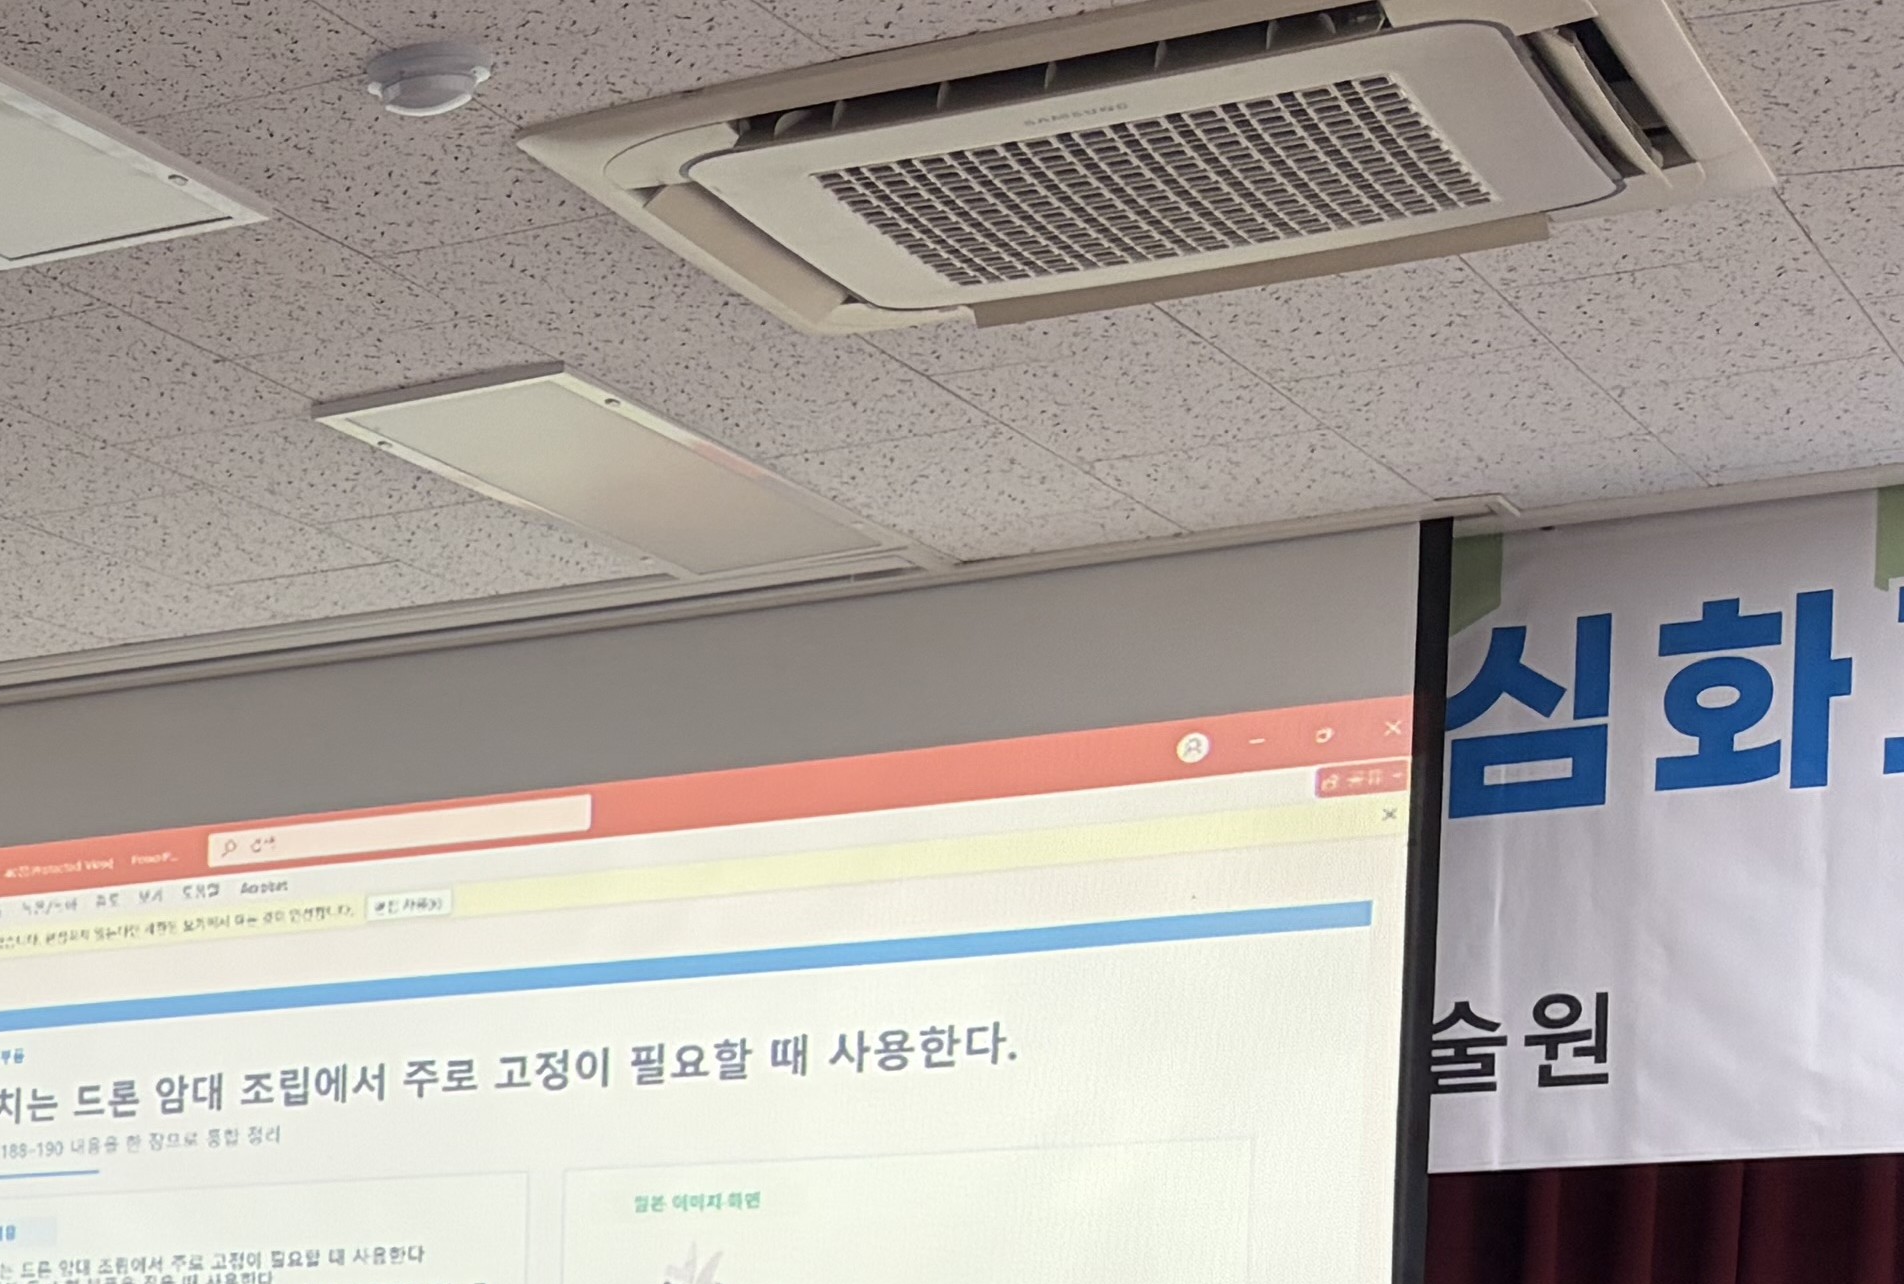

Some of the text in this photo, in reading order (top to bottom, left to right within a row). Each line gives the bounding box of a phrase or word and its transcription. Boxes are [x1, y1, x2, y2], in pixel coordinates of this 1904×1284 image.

[1445, 588, 1904, 820] 심화
[73, 1079, 141, 1119] 드론
[155, 1071, 224, 1115] 암대
[240, 1063, 386, 1107] 조립에서
[403, 1058, 479, 1099] 주로
[494, 1046, 611, 1091] 고정이
[630, 1037, 754, 1086] 필요할
[770, 1033, 809, 1077] 때
[828, 1021, 1018, 1073] 사용한다.
